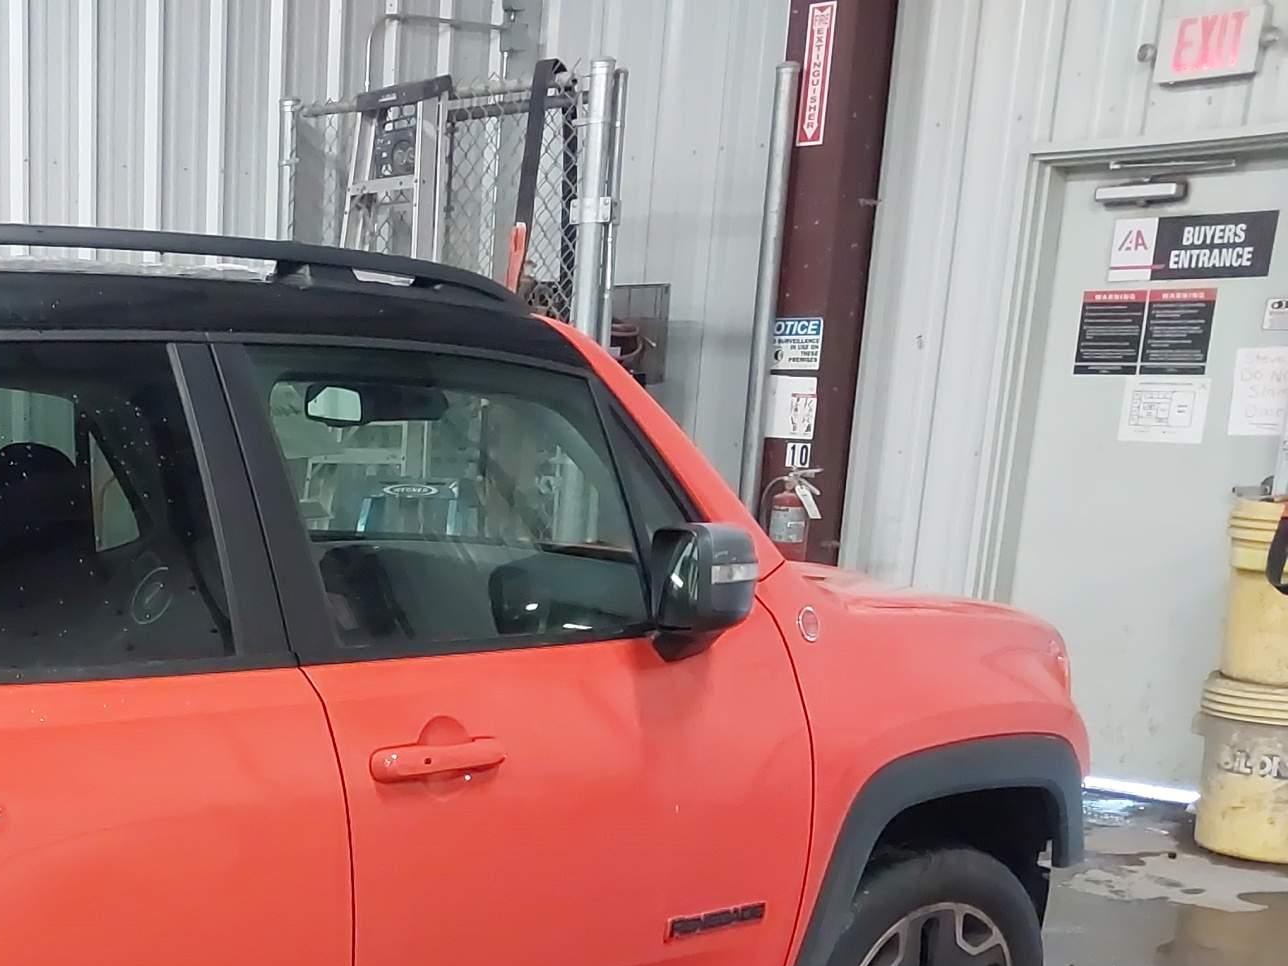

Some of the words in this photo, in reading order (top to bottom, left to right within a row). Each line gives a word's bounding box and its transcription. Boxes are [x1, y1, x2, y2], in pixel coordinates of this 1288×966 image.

[1171, 11, 1250, 73] EXIT
[806, 28, 824, 129] EXTINGUISHER
[1182, 223, 1247, 246] BUYERS
[1168, 247, 1254, 269] ENTRANCE
[774, 320, 820, 335] OTICE
[790, 444, 808, 466] 10
